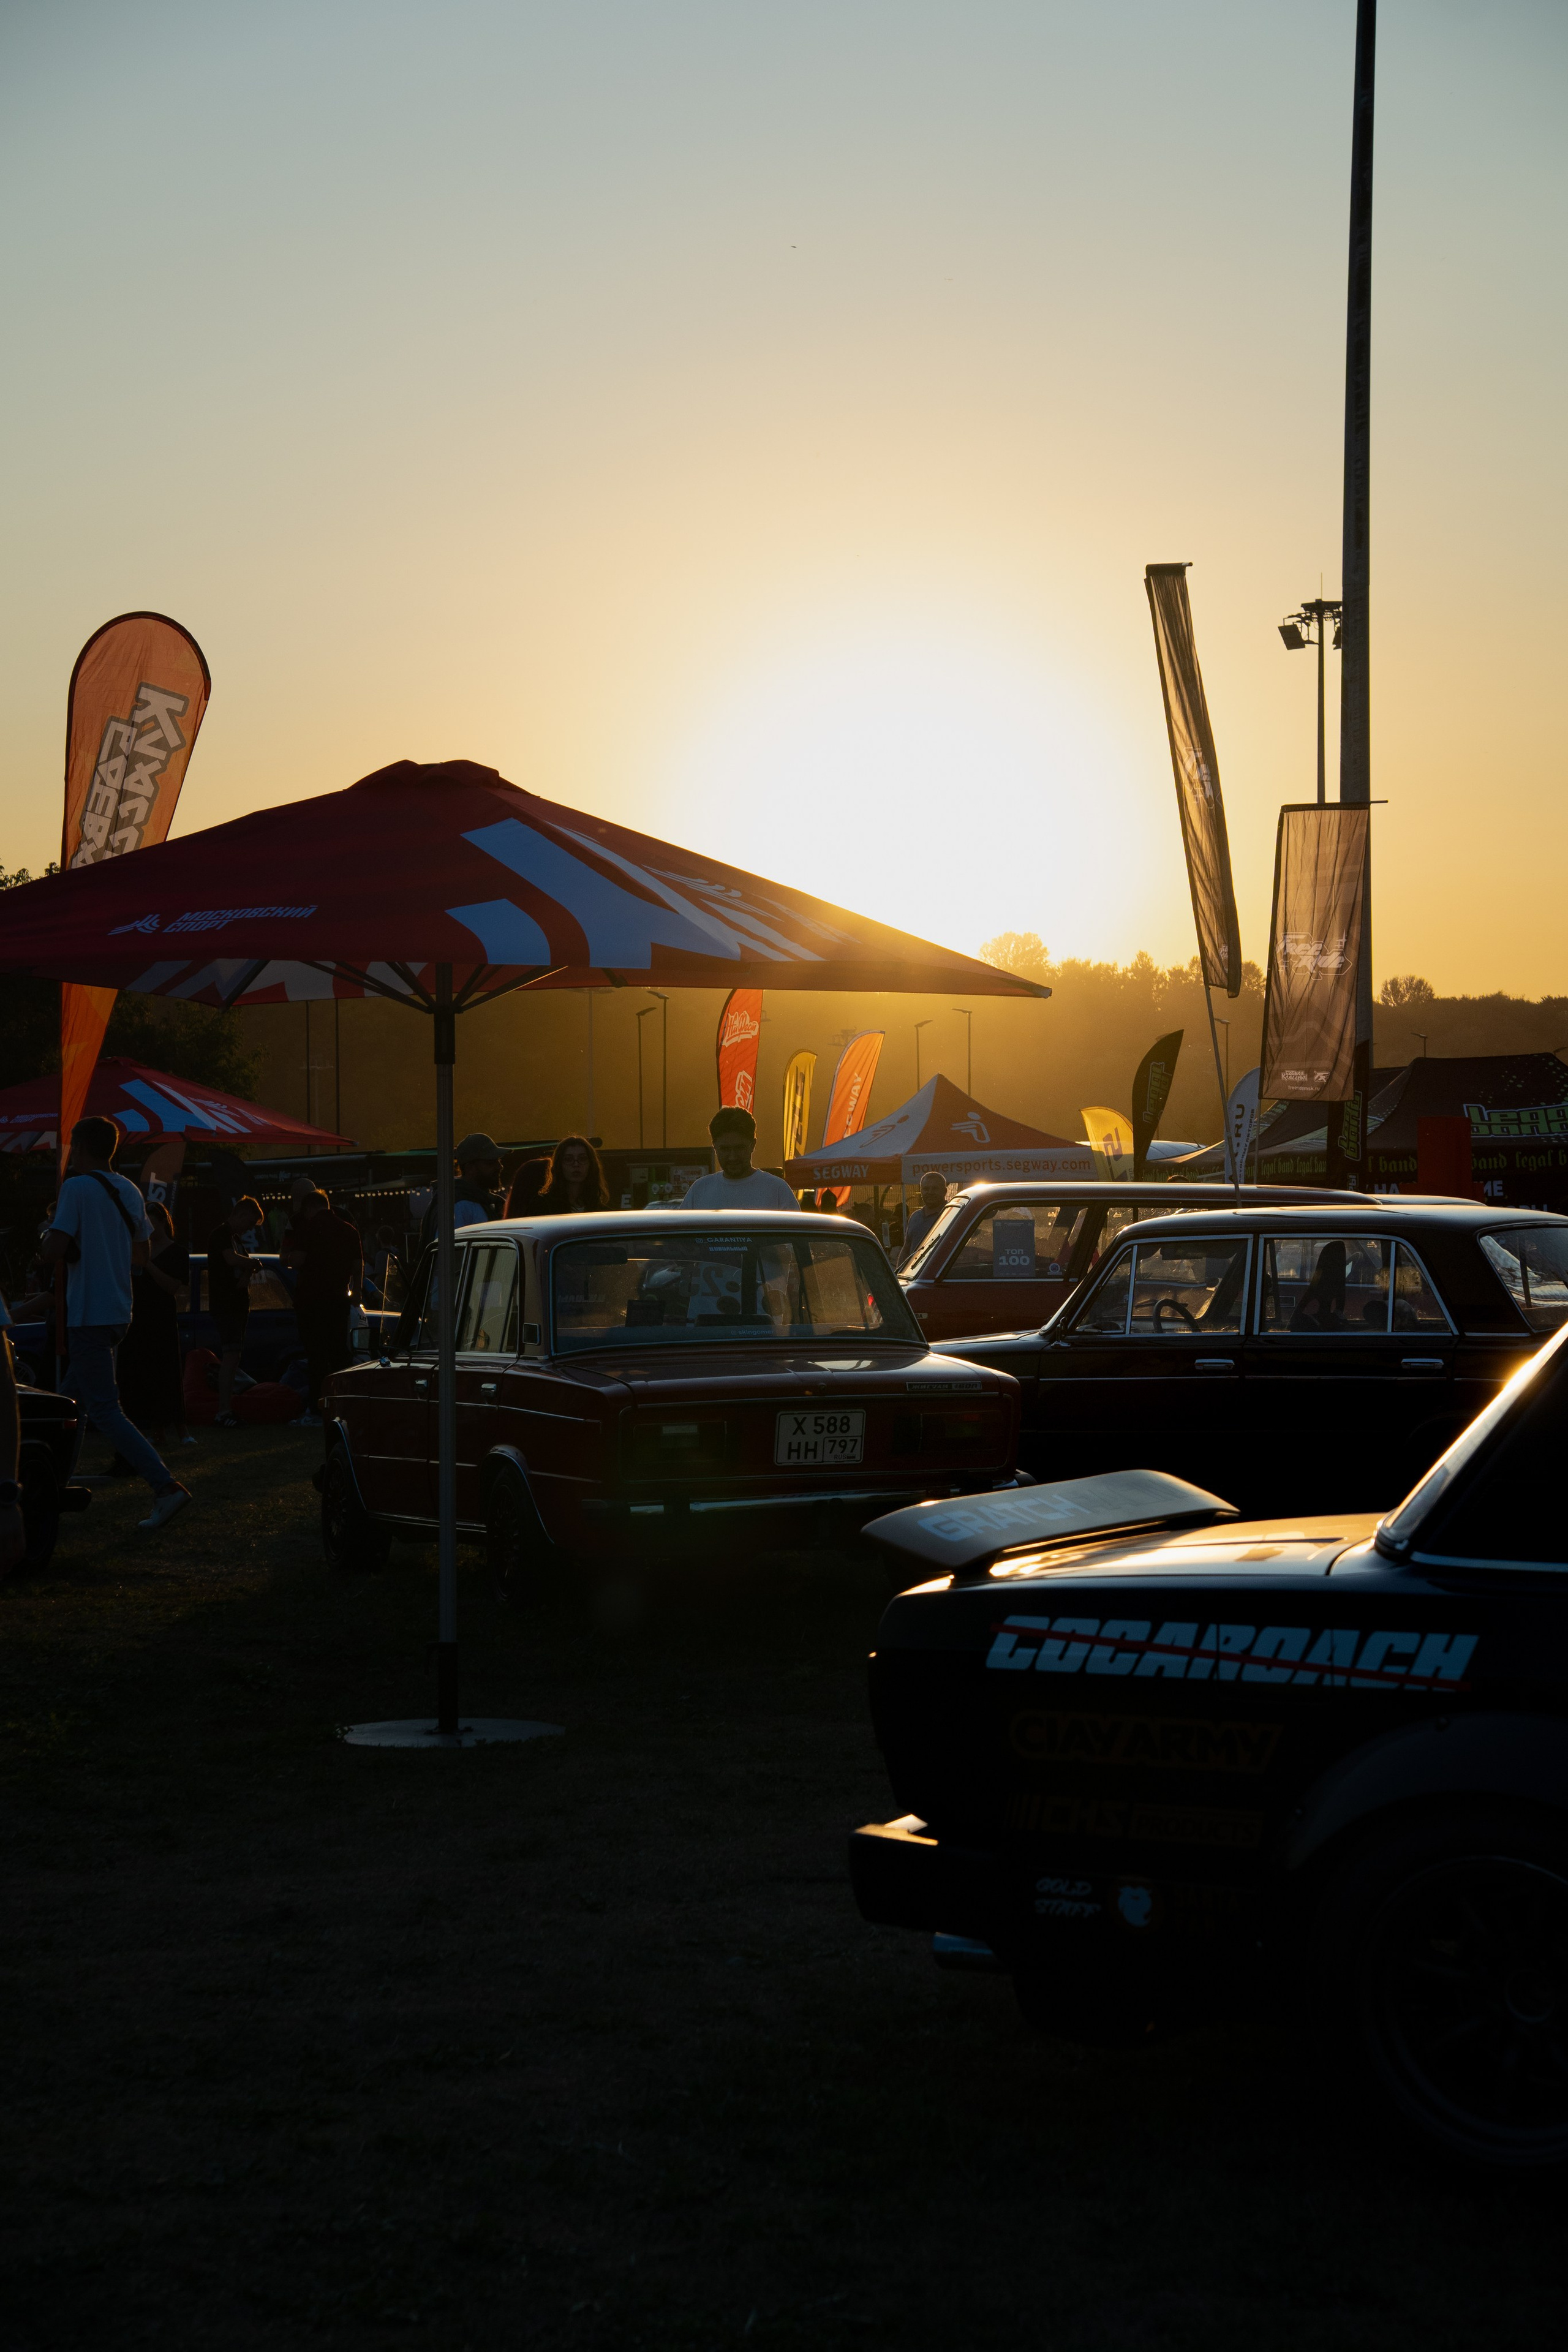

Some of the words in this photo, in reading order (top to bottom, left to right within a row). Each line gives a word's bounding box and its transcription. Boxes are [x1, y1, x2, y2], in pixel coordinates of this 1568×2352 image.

[176, 905, 318, 922] МОСКОВСКИЙ
[161, 919, 234, 933] СПОРТ
[843, 1072, 862, 1139] EGWAY
[912, 1159, 1091, 1176] powersports.segway.com
[1379, 1155, 1417, 1173] band
[1515, 1150, 1553, 1172] legal
[813, 1165, 869, 1181] SEGWAY
[998, 1256, 1030, 1266] 100
[793, 1417, 807, 1435] X
[813, 1415, 851, 1434] 588
[787, 1441, 818, 1460] HH
[827, 1439, 858, 1454] 797
[917, 1493, 1091, 1543] GRATCH
[1134, 1813, 1258, 1844] PRODUCTS
[1035, 1876, 1093, 1897] GOLD
